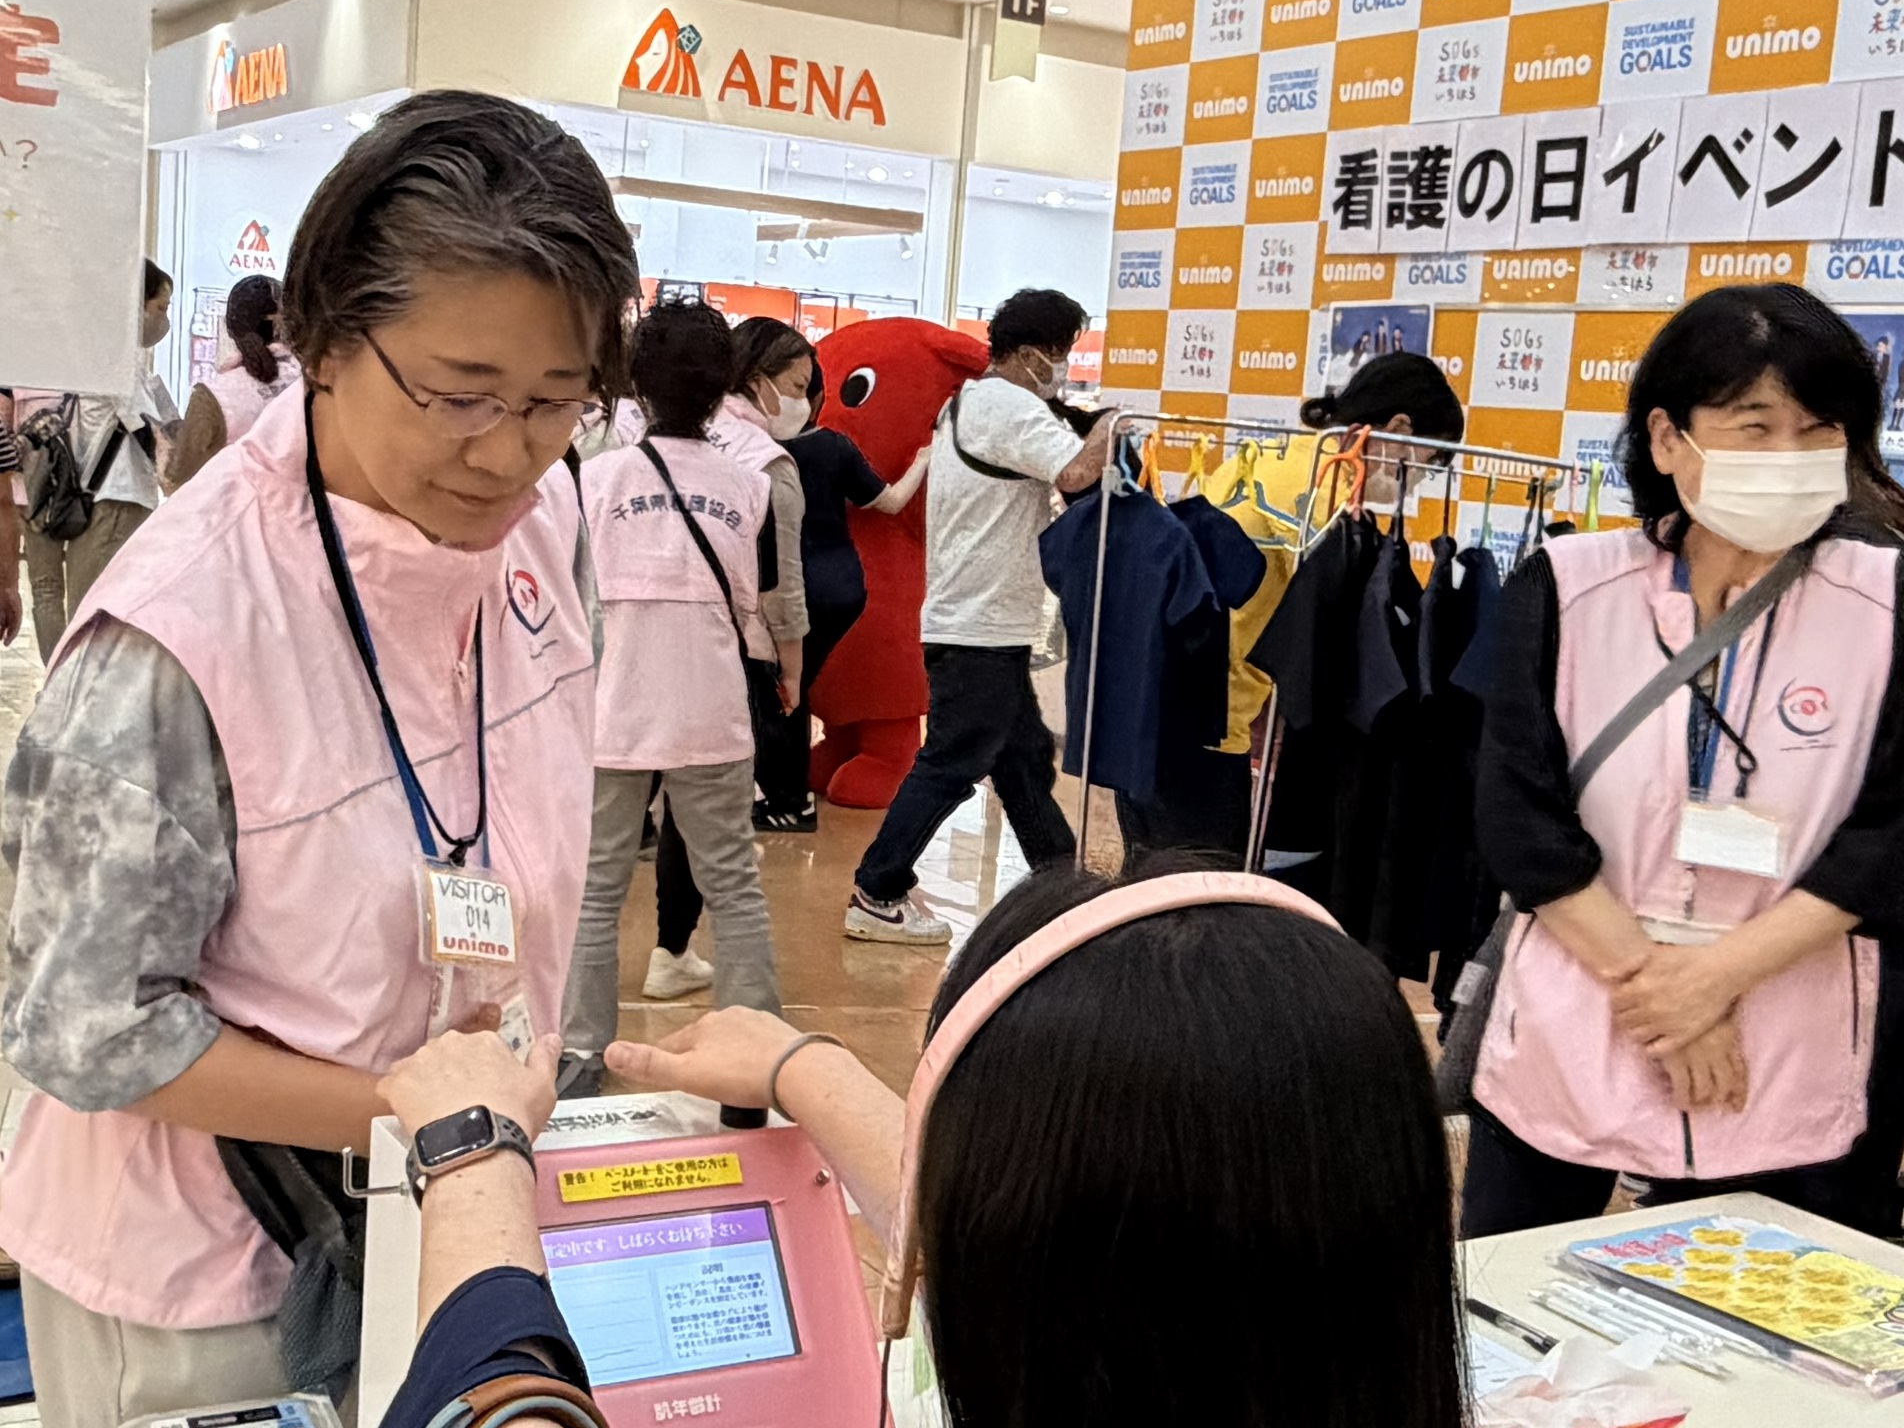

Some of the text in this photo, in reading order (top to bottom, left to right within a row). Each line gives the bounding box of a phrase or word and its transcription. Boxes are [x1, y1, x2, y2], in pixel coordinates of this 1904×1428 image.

[1134, 21, 1187, 46] unimo
[1623, 18, 1695, 37] SUSTAINABLE
[1622, 32, 1694, 50] DEVELOPMENT
[1725, 26, 1821, 59] unimo
[1514, 53, 1592, 83] unimo
[1620, 46, 1693, 75] GOALS
[235, 42, 287, 107] AENA
[717, 48, 889, 127] AENA
[1339, 76, 1404, 103] unimo
[1193, 95, 1248, 119] unimo
[1266, 89, 1317, 114] GOALS
[1121, 186, 1172, 206] unimo
[1189, 185, 1236, 205] GOALS
[1254, 176, 1314, 198] unimo
[230, 253, 276, 271] AENA
[1322, 262, 1386, 283] unimo
[1492, 257, 1568, 280] unimo
[1700, 252, 1792, 278] unimo
[1118, 270, 1161, 289] GOALS
[1178, 265, 1233, 285] unimo
[1408, 263, 1468, 285] GOALS
[1108, 347, 1158, 365] unimo
[1238, 350, 1297, 370] unimo
[438, 877, 506, 907] VISITOR
[466, 905, 490, 931] 014
[443, 935, 509, 957] unimo
